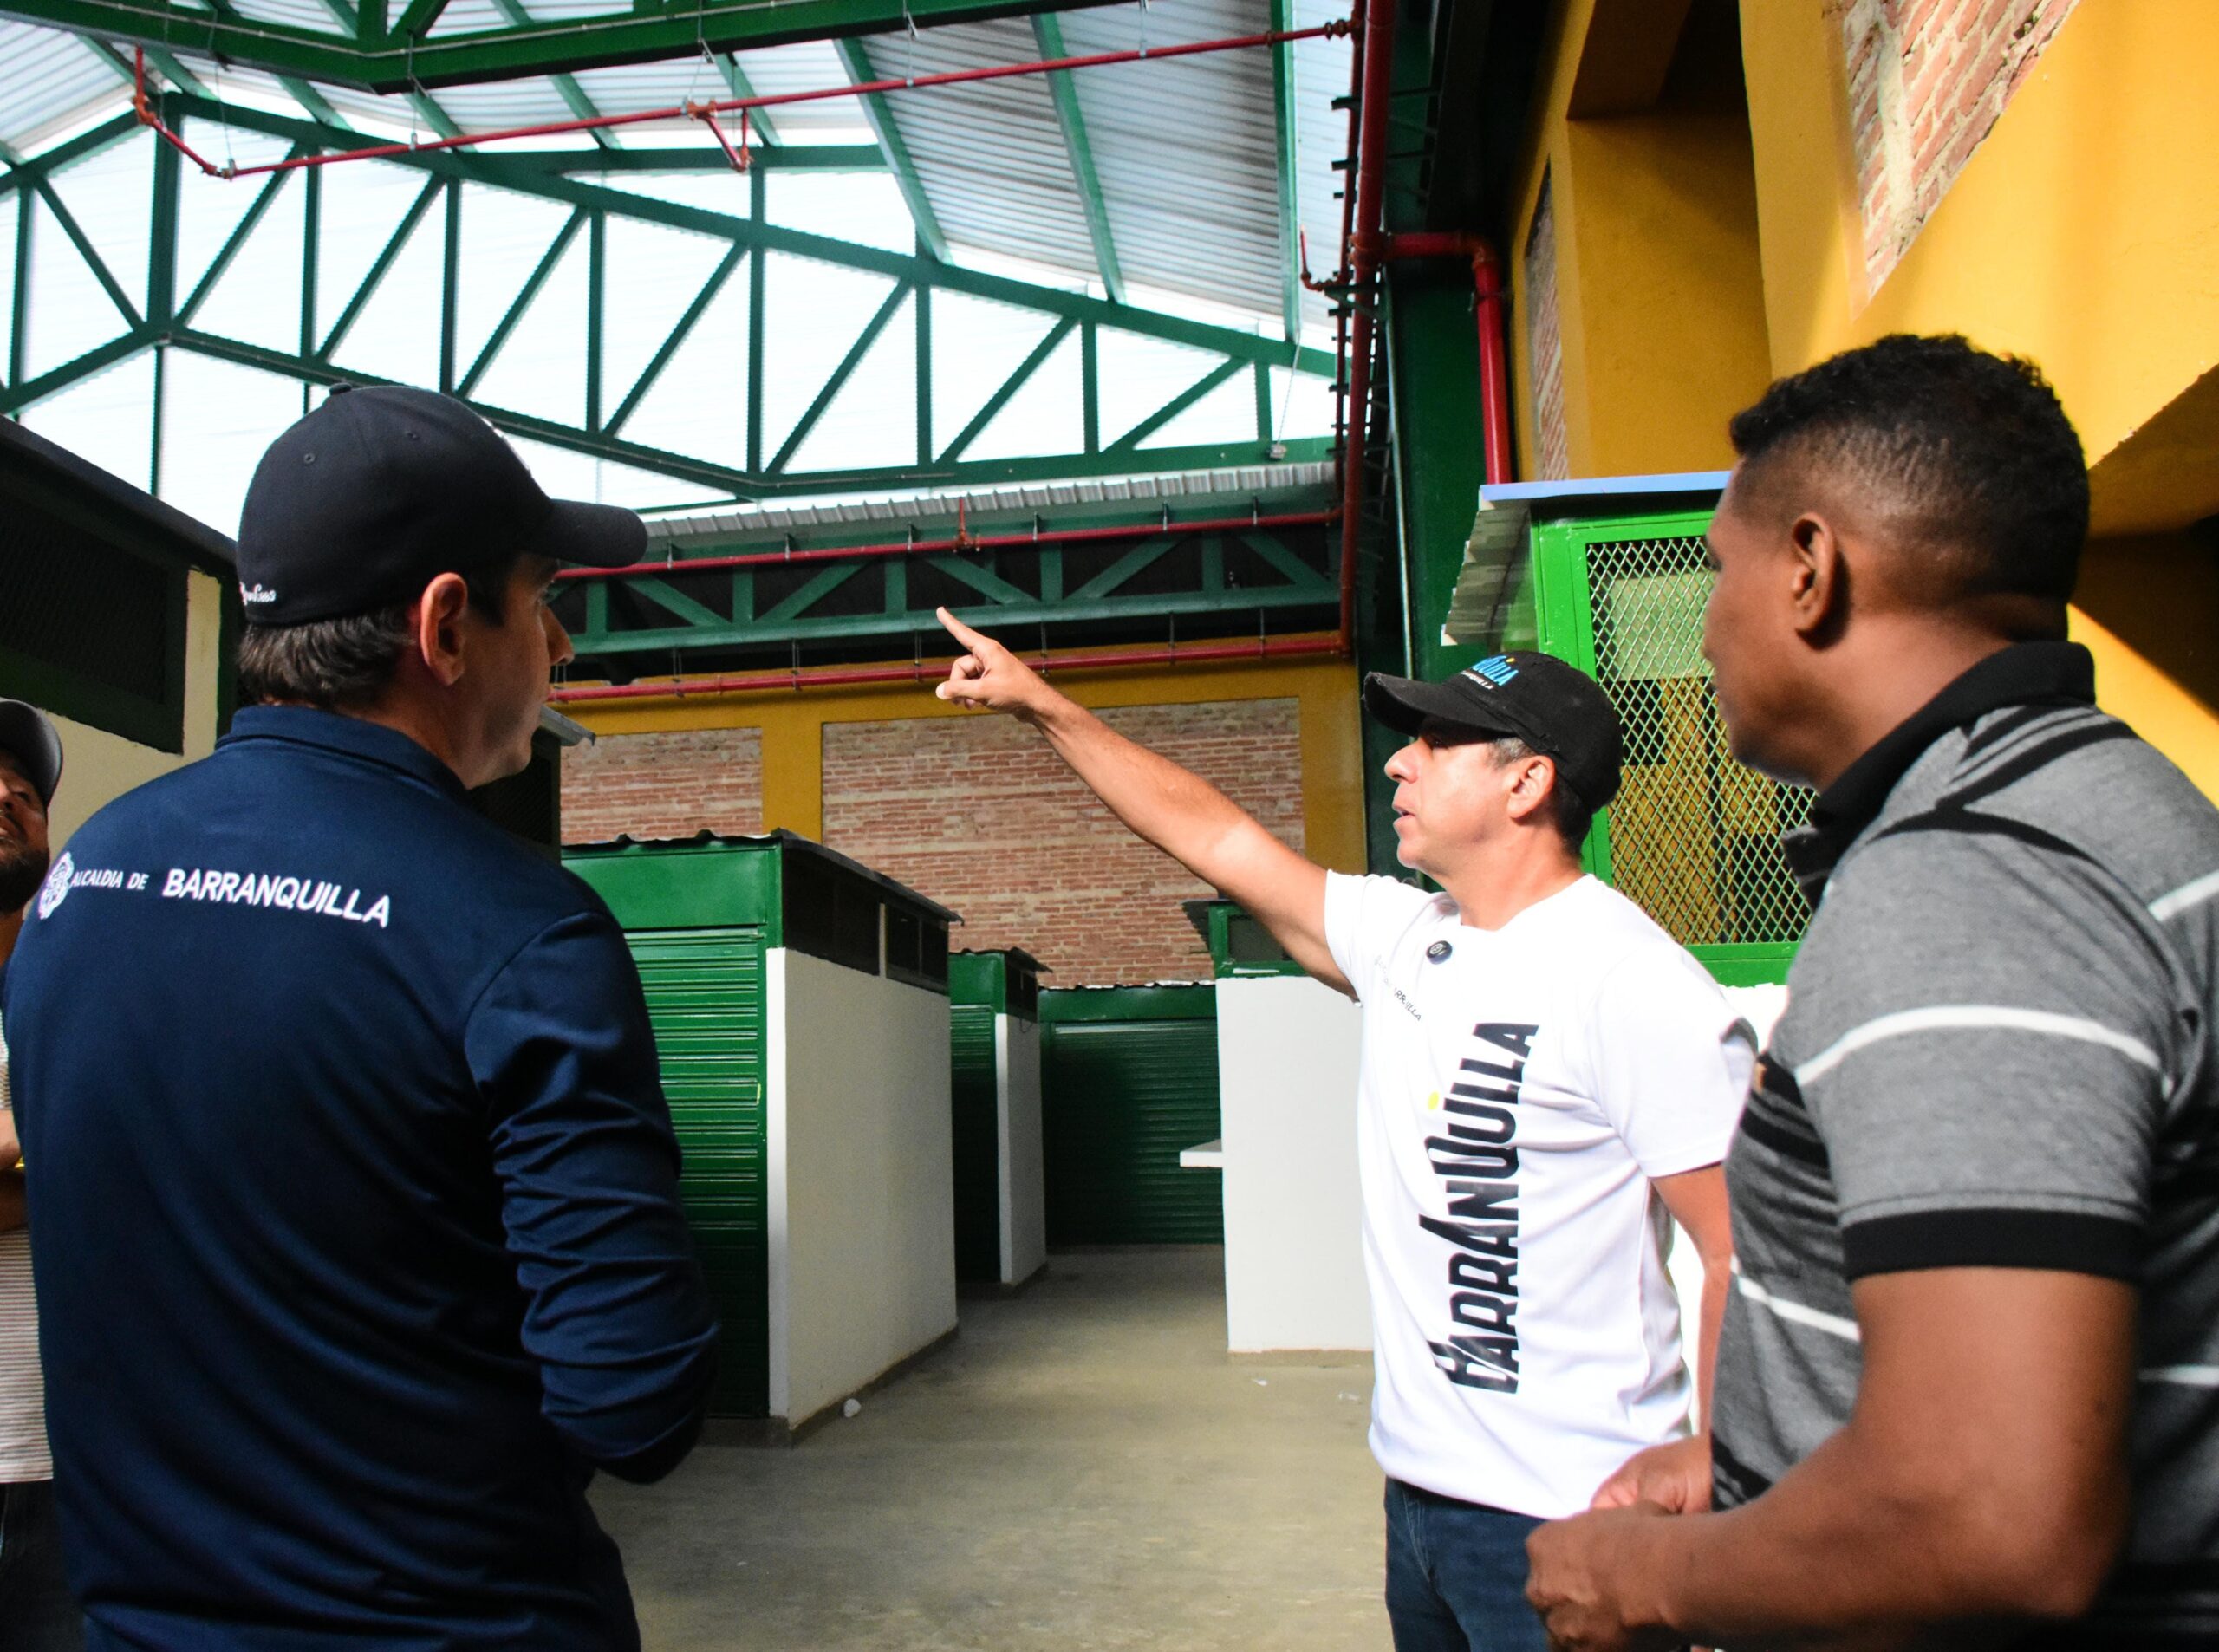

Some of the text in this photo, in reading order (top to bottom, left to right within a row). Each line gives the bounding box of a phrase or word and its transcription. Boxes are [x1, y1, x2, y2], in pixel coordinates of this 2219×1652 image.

[70, 868, 391, 927] ALCALDIA DE BARRANQUILLA
